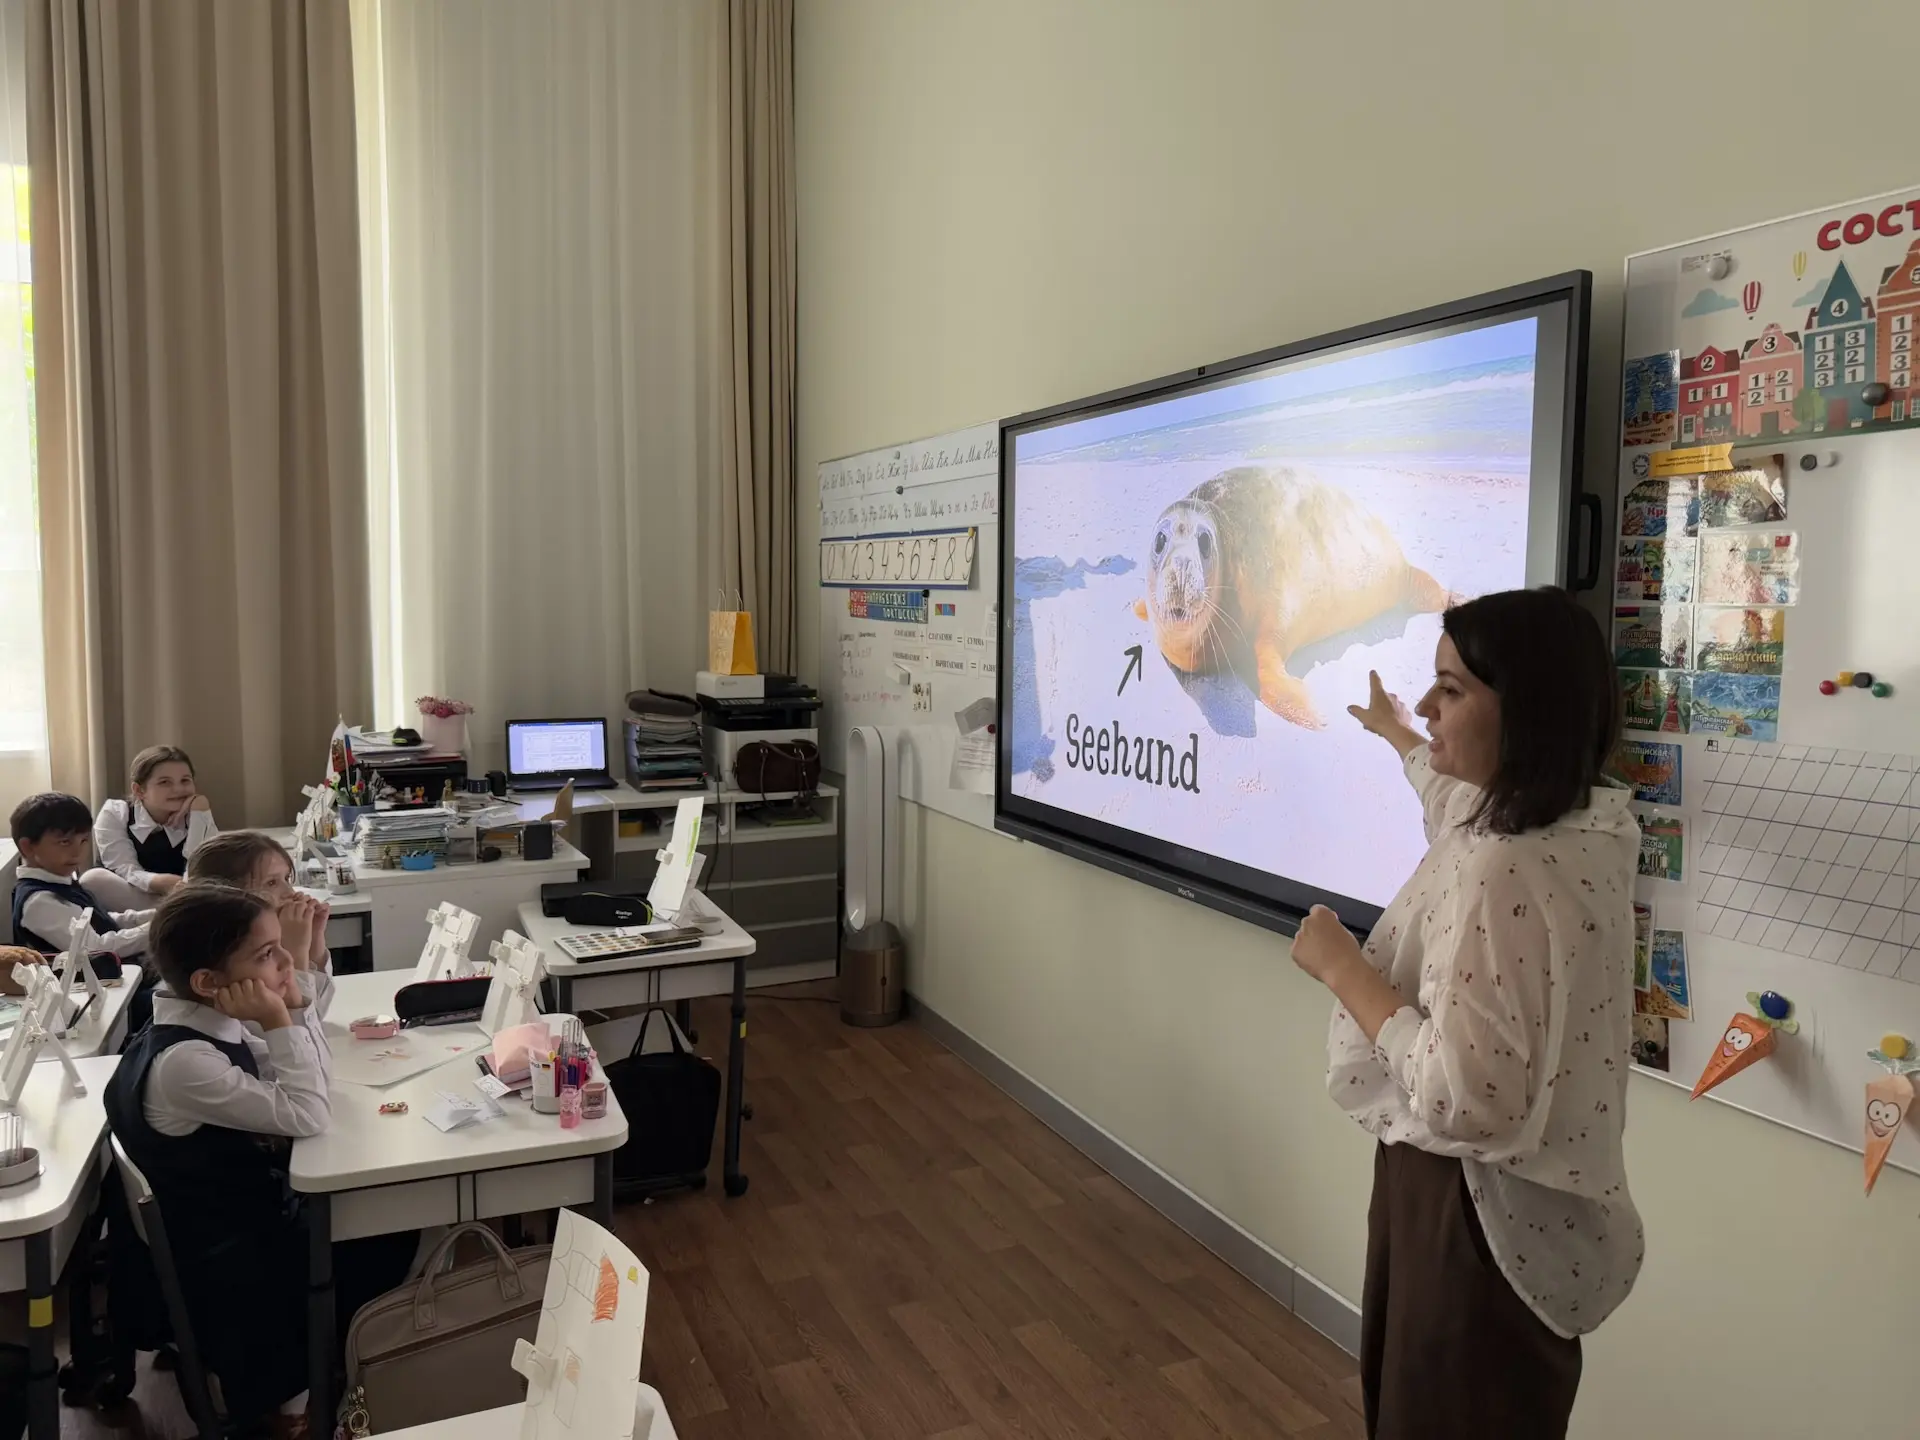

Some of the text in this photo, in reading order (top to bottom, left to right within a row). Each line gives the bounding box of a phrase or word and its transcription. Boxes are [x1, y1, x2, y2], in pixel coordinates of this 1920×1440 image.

[1832, 301, 1845, 314] 4
[1896, 317, 1906, 330] 1
[1764, 336, 1775, 350] 3
[1818, 336, 1827, 349] 1
[1847, 331, 1860, 345] 3
[1895, 335, 1907, 349] 2
[1702, 356, 1713, 369] 2
[1817, 354, 1829, 368] 2
[1847, 350, 1859, 364] 2
[1894, 354, 1907, 369] 3
[1751, 375, 1760, 387] 1
[1777, 370, 1789, 383] 2
[1817, 372, 1829, 386] 3
[1848, 368, 1857, 381] 1
[1894, 373, 1906, 386] 4
[1690, 389, 1698, 401] 1
[1714, 384, 1722, 397] 1
[1750, 391, 1761, 404] 2
[1778, 387, 1787, 400] 1
[1066, 713, 1200, 794] Seehund
